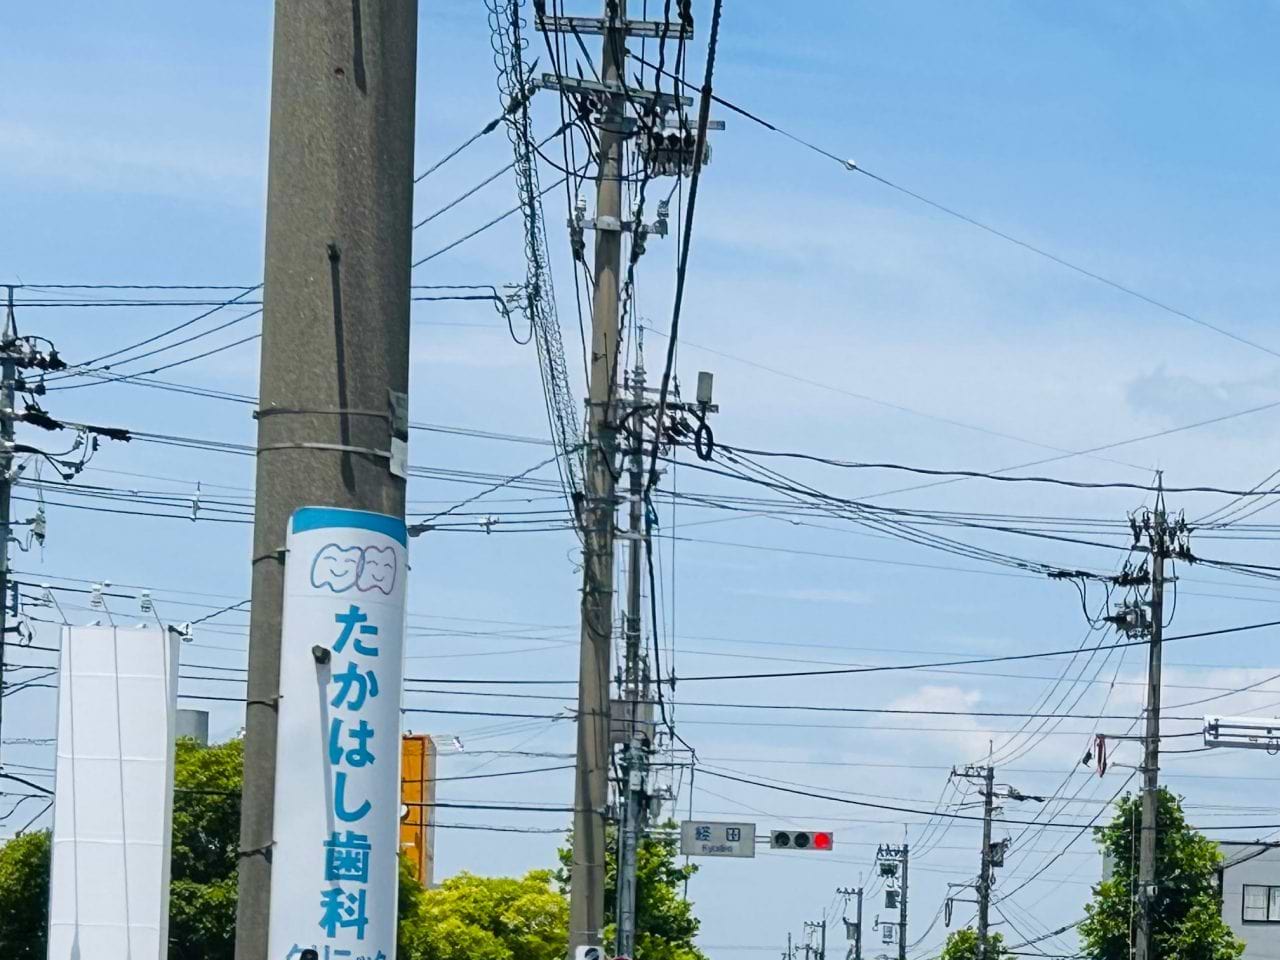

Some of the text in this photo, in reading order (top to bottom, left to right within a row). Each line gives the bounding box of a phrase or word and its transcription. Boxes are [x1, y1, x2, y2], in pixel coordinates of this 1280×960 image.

[317, 603, 381, 941] たかはし歯科
